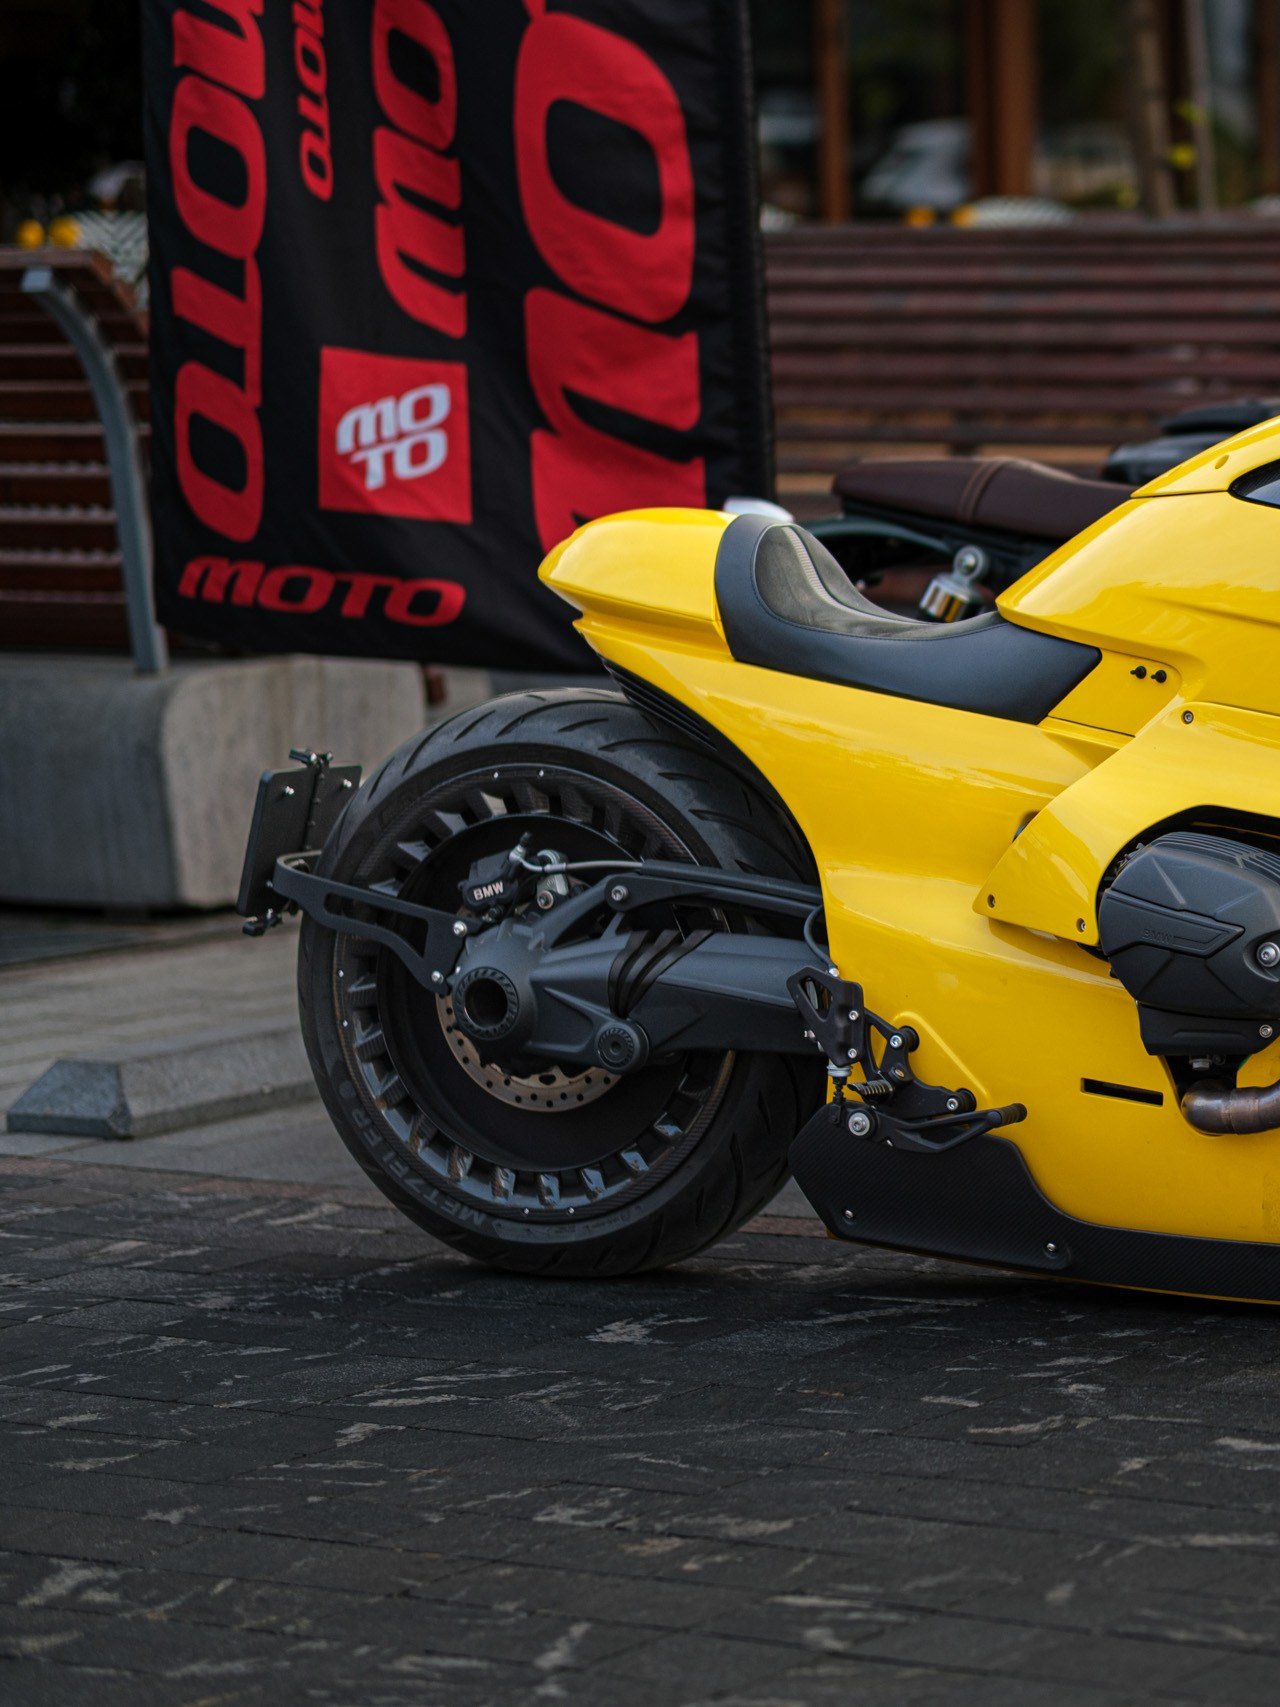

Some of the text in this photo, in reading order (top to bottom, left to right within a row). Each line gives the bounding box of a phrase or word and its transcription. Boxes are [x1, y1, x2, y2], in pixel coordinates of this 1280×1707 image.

[336, 383, 451, 454] MO
[350, 429, 448, 491] TO
[178, 555, 466, 628] MOTO
[473, 881, 504, 901] BMW
[1142, 927, 1174, 944] BMW
